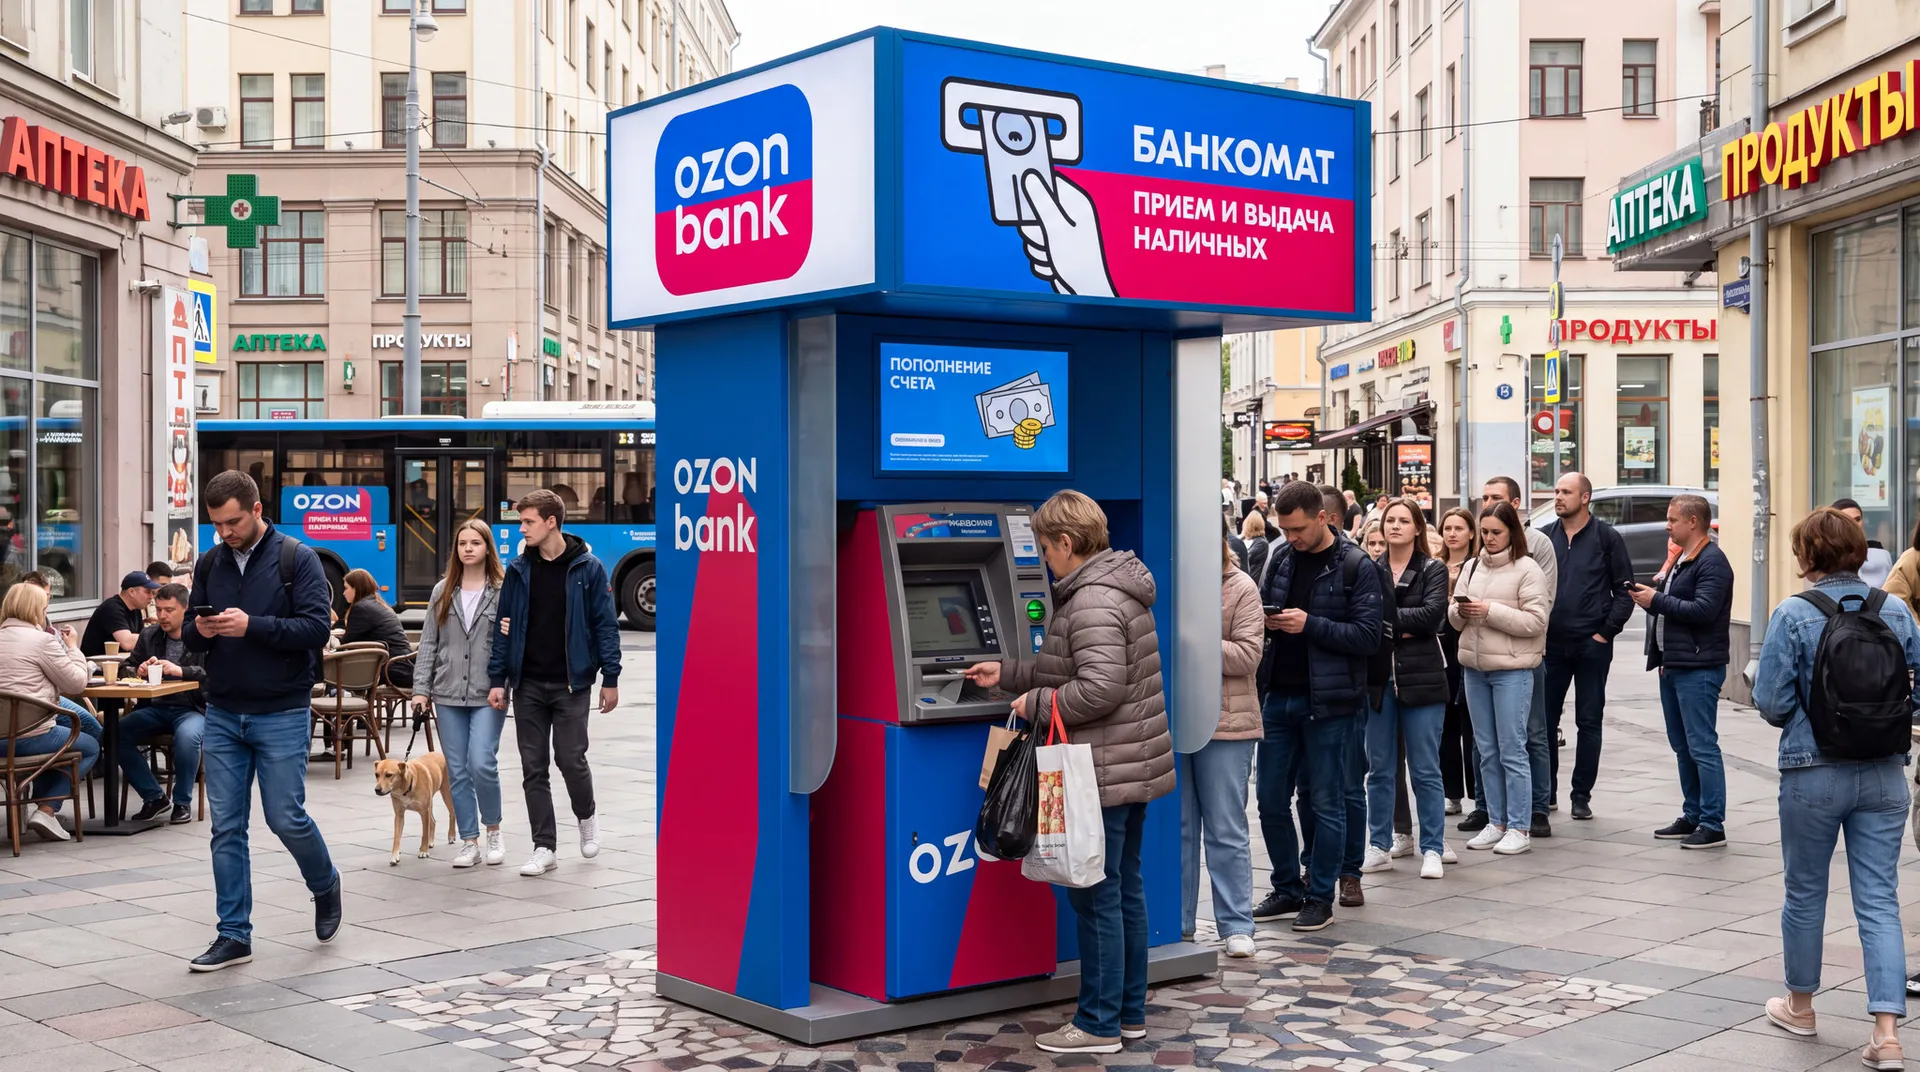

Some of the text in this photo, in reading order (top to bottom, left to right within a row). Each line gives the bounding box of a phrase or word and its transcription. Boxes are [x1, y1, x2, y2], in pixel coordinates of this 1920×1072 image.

[1722, 60, 1918, 201] ПРОДУКТЫ
[2, 116, 150, 221] АПТЕКА
[675, 131, 788, 200] ozon
[1133, 125, 1334, 185] БАНКОМАТ
[675, 185, 788, 255] bank
[1133, 191, 1335, 235] ПРИЕМ И ВЫДАЧА
[1606, 163, 1696, 248] АПТЕКА
[1133, 226, 1268, 260] НАЛИЧНЫХ
[233, 333, 327, 351] АПТЕКА
[372, 333, 471, 348] ПРОУКТЫ
[890, 357, 992, 375] ПОПОЛНЕНИЕ
[890, 375, 936, 391] СЧЕТА
[674, 457, 757, 495] OZON
[293, 493, 361, 510] OZON
[674, 503, 756, 553] bank
